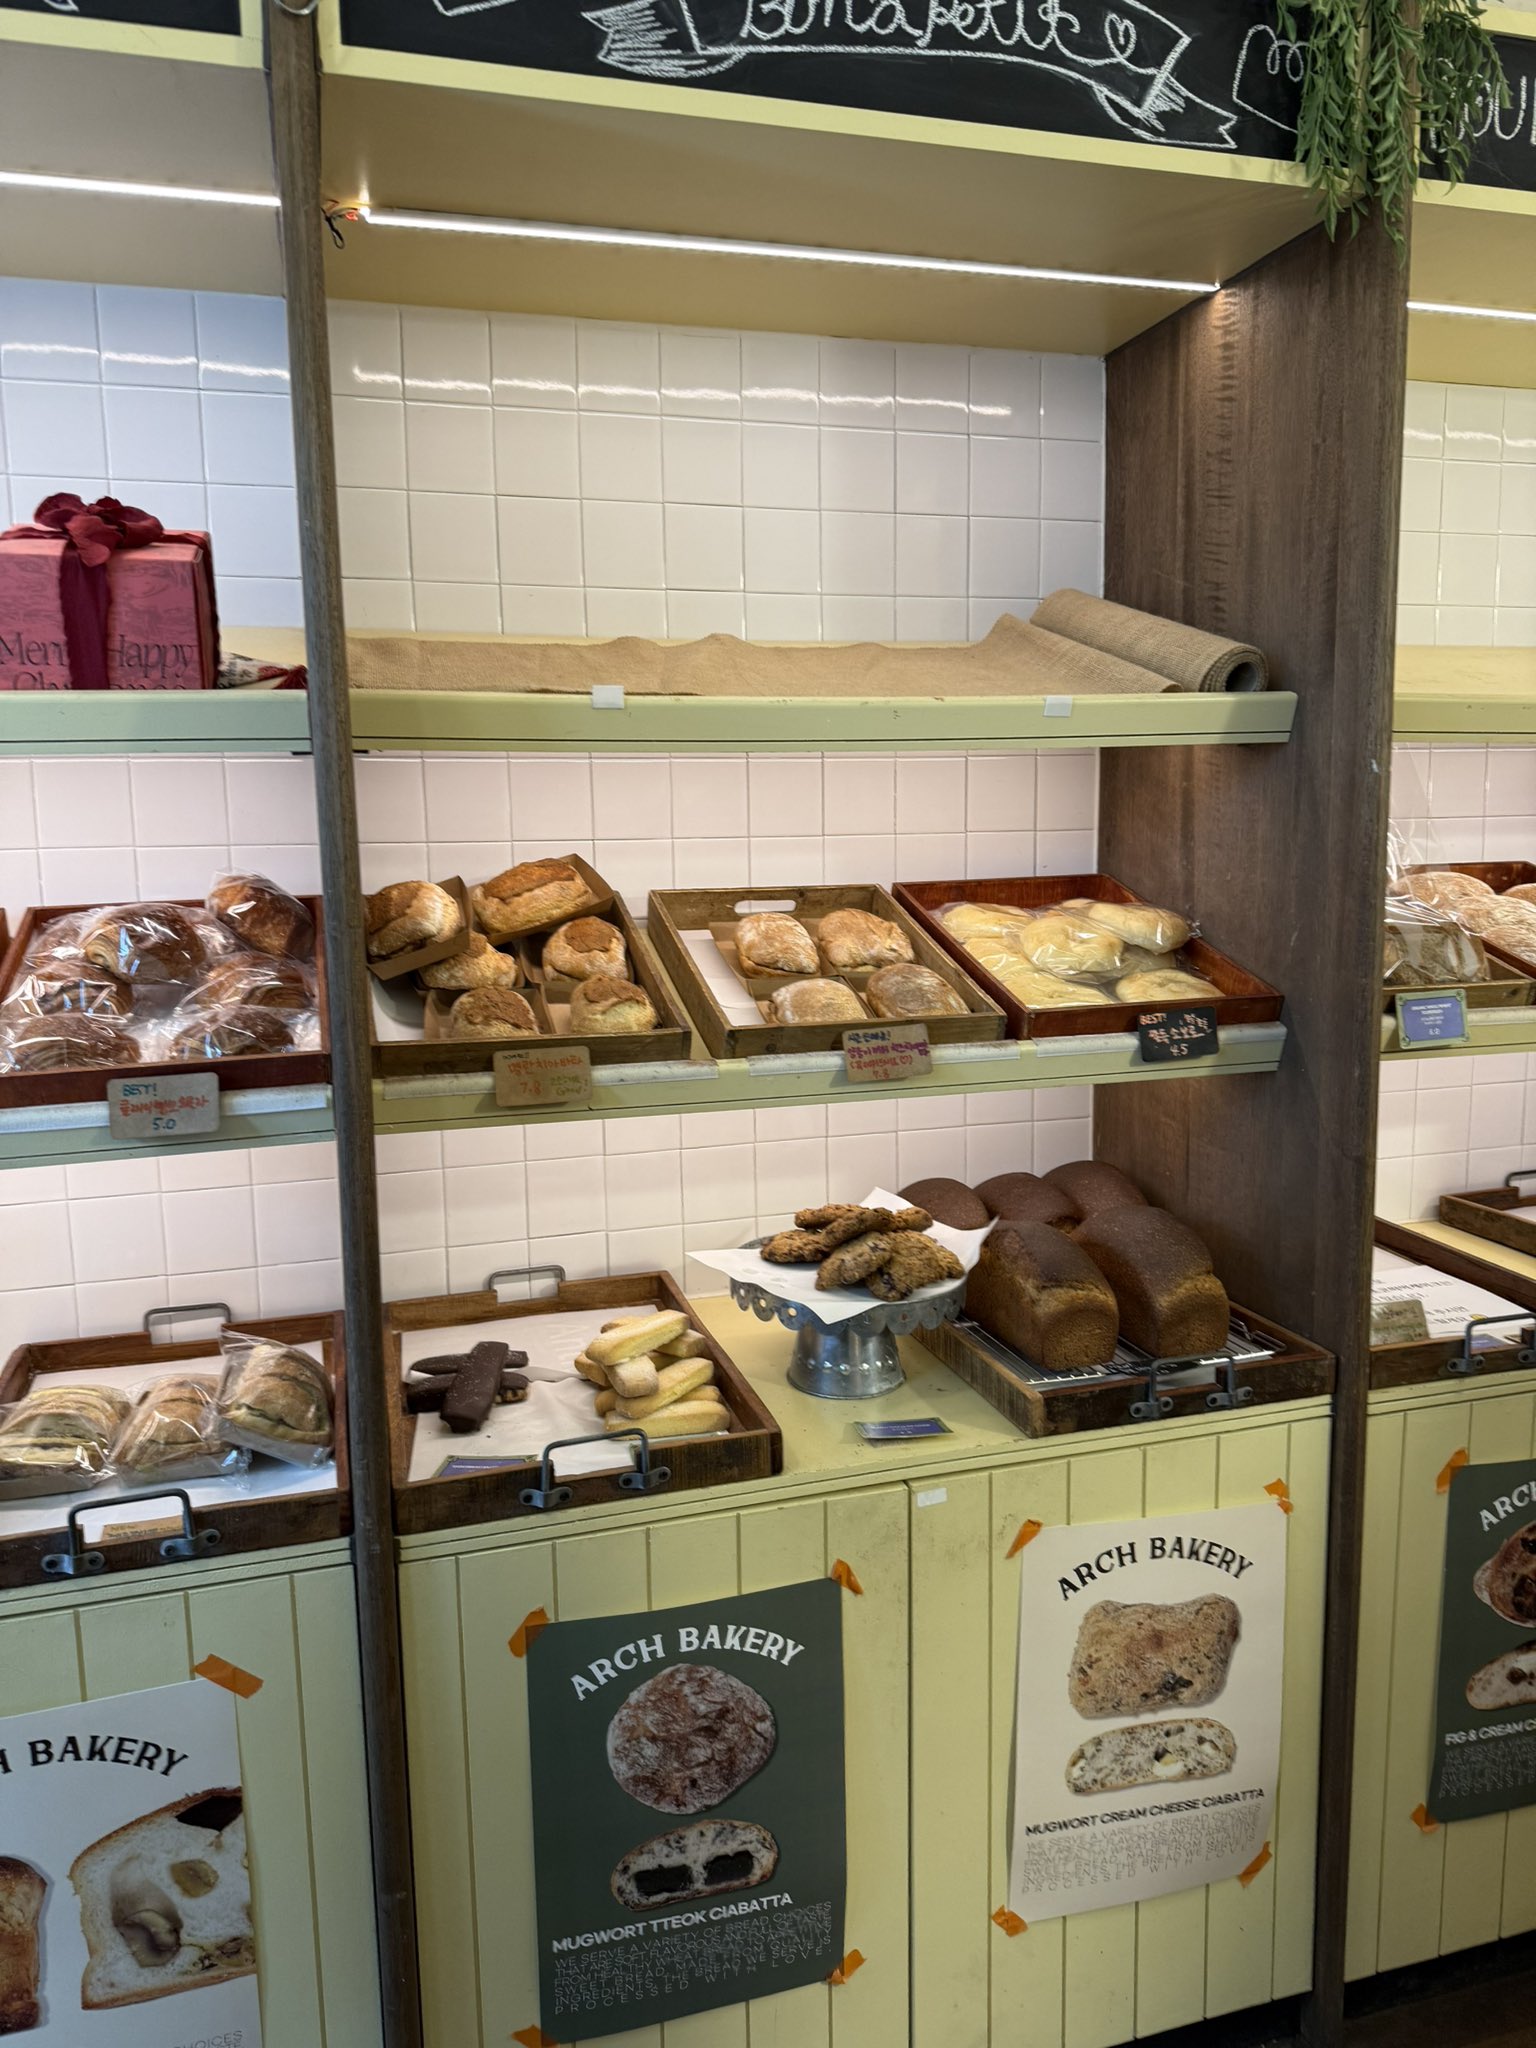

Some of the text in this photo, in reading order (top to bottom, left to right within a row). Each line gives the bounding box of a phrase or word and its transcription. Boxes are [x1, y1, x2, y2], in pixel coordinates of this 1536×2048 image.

[122, 1083, 157, 1097] BEST!
[519, 1080, 543, 1096] 7.8
[152, 1117, 177, 1131] 5.0
[1057, 1536, 1254, 1601] ARCH BAKERY
[570, 1624, 806, 1701] ARCH BAKERY
[27, 1735, 189, 1776] BAKERY
[1024, 1788, 1265, 1837] MUGWORT CREAM CHEESE CIABATTA
[552, 1892, 793, 1953] MUGWORT TTEOK CIABATTA
[581, 1945, 624, 1964] SERVE
[629, 1942, 638, 1953] A
[642, 1930, 697, 1951] VARIETY
